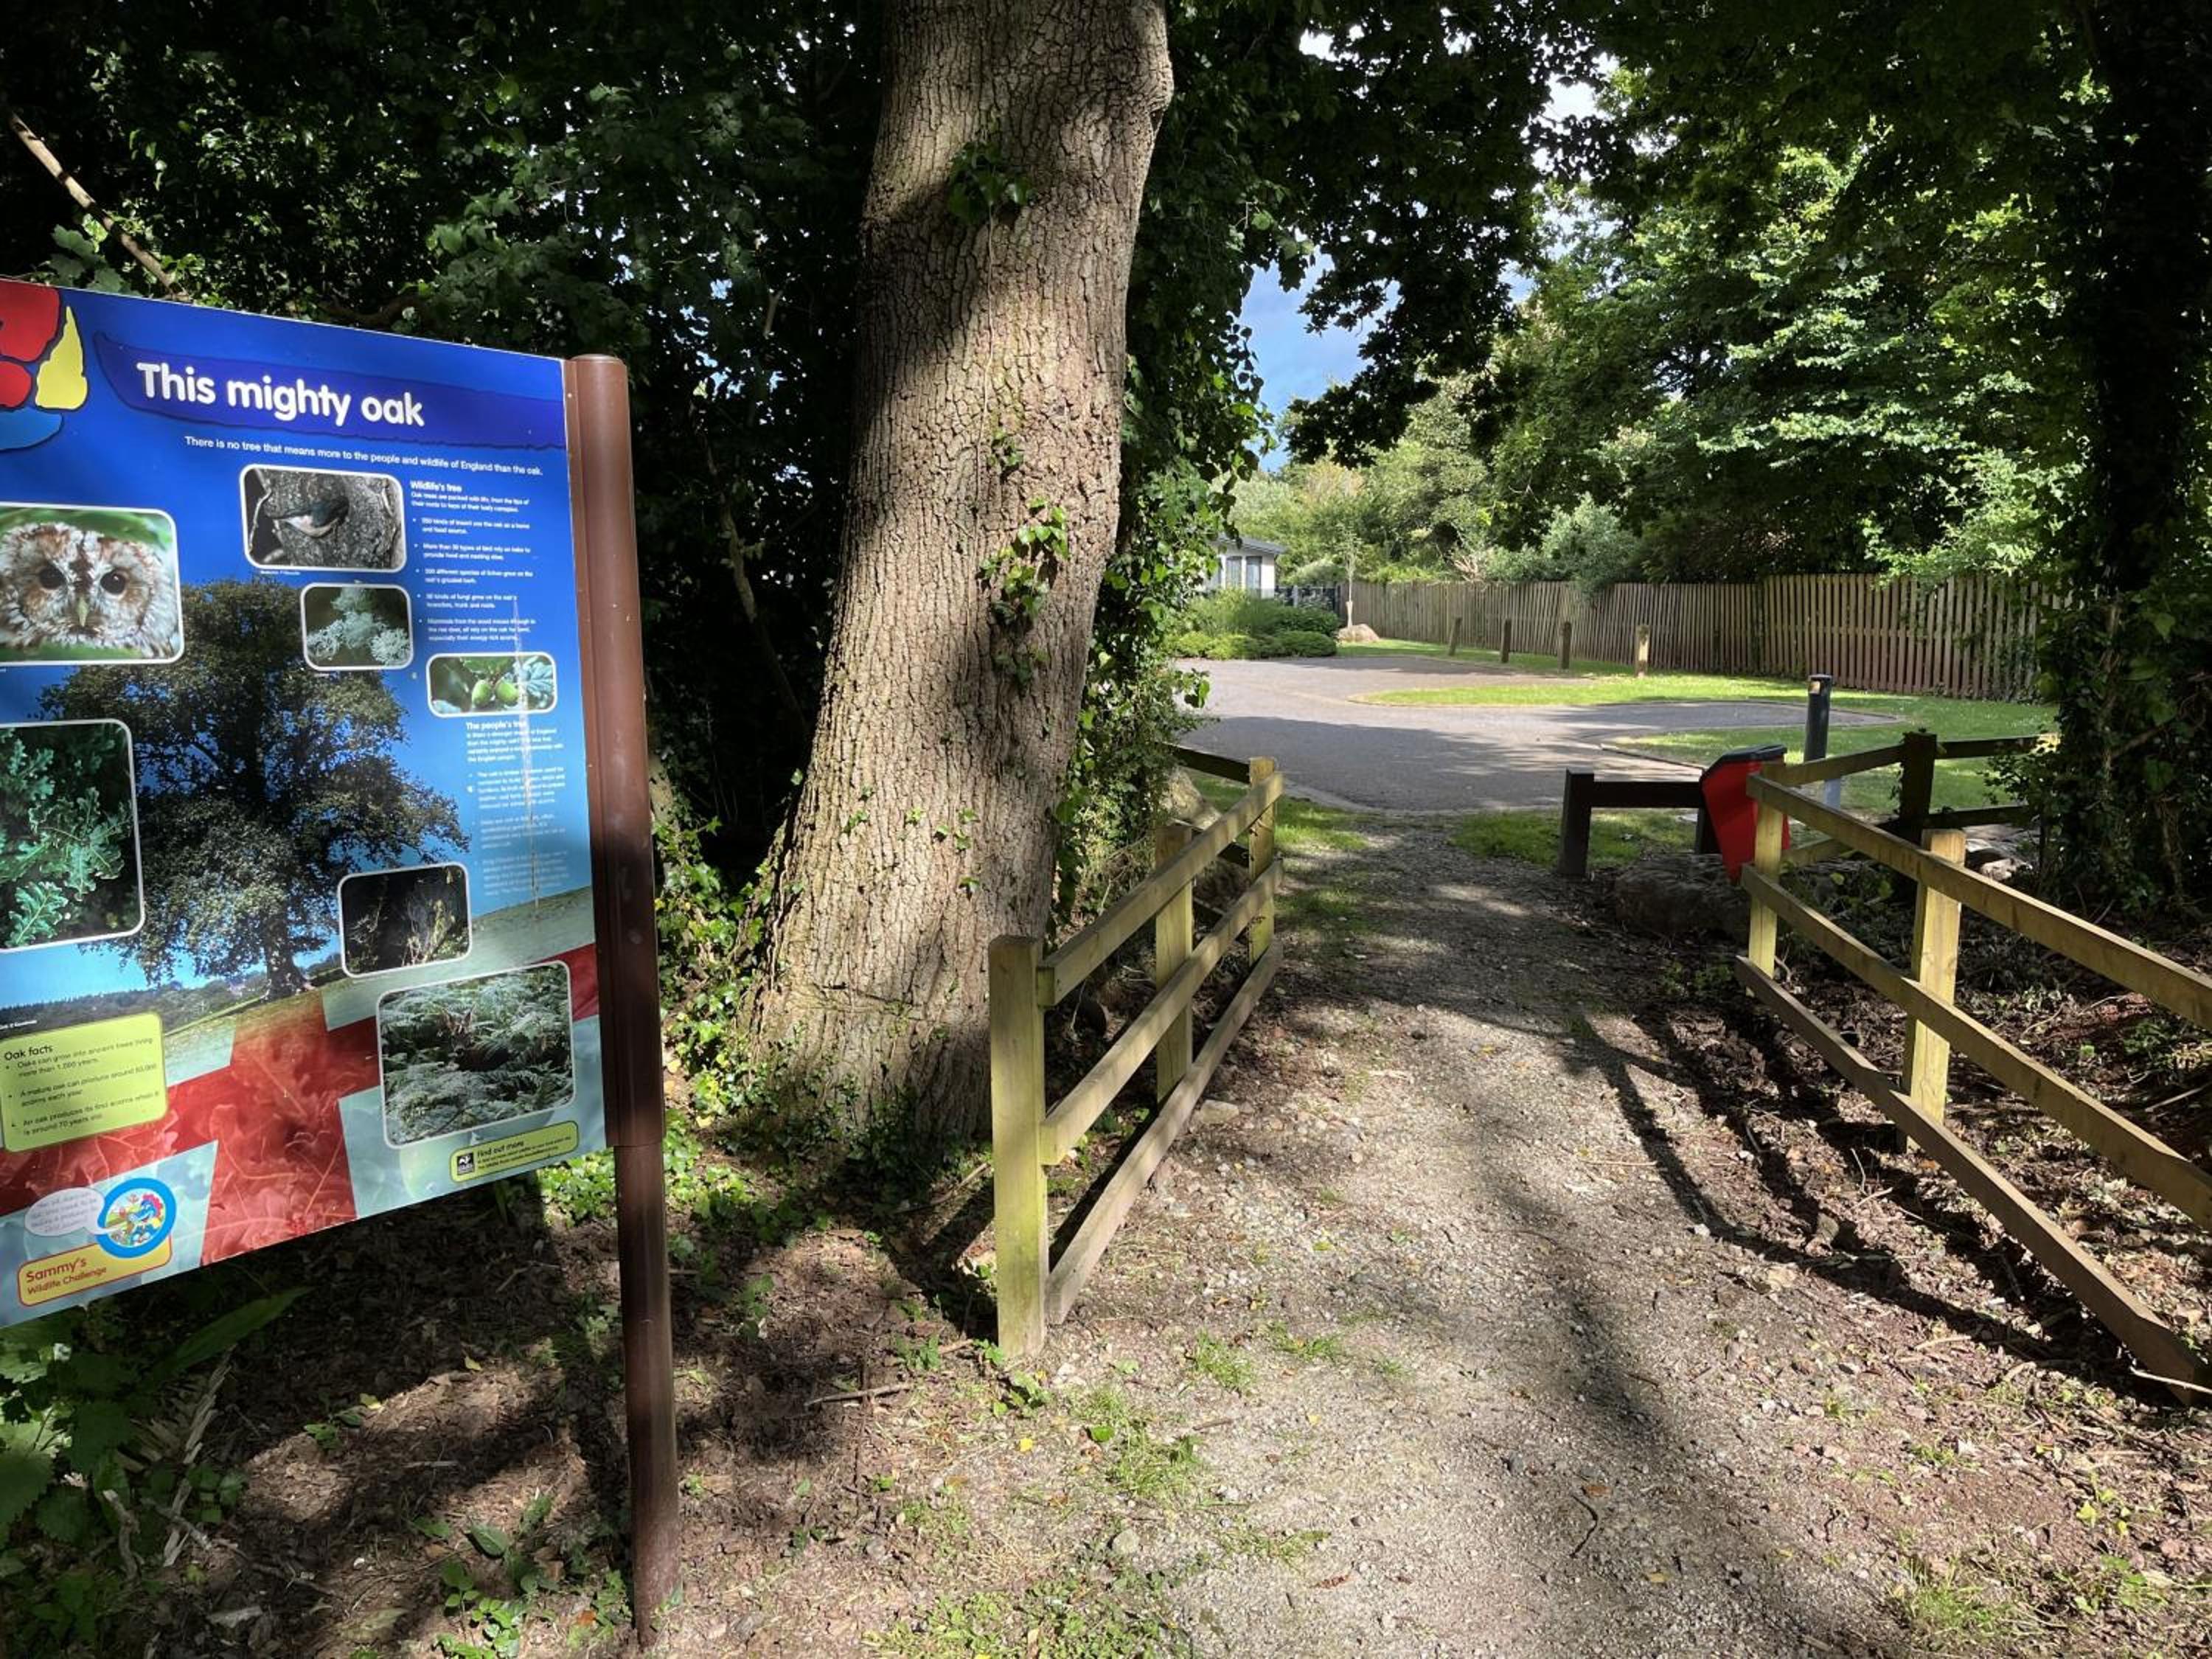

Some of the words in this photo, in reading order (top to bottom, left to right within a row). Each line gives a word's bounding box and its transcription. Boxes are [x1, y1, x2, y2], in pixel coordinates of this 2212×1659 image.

[137, 362, 216, 404] This
[227, 375, 351, 426] mighty
[361, 392, 425, 426] oak
[185, 436, 214, 448] There
[217, 439, 225, 448] is
[227, 441, 239, 449] no
[243, 442, 260, 451] tree
[263, 442, 282, 453] that
[285, 446, 315, 456] means
[318, 449, 340, 459] more
[343, 450, 352, 459] to
[354, 451, 368, 461] the
[371, 453, 400, 465] people
[403, 456, 417, 465] and
[420, 457, 448, 467] wildlife
[451, 460, 459, 468] of
[462, 461, 493, 472] England
[494, 464, 511, 473] than
[513, 465, 525, 473] the
[410, 480, 445, 491] Wildlife's
[4, 1049, 26, 1061] Oak
[28, 1044, 54, 1057] facts
[477, 1149, 492, 1157] Find
[493, 1144, 505, 1153] out
[507, 1141, 524, 1150] more
[26, 1256, 87, 1283] Sammy's
[27, 1280, 61, 1295] Wildlife
[63, 1266, 107, 1284] Challenge
